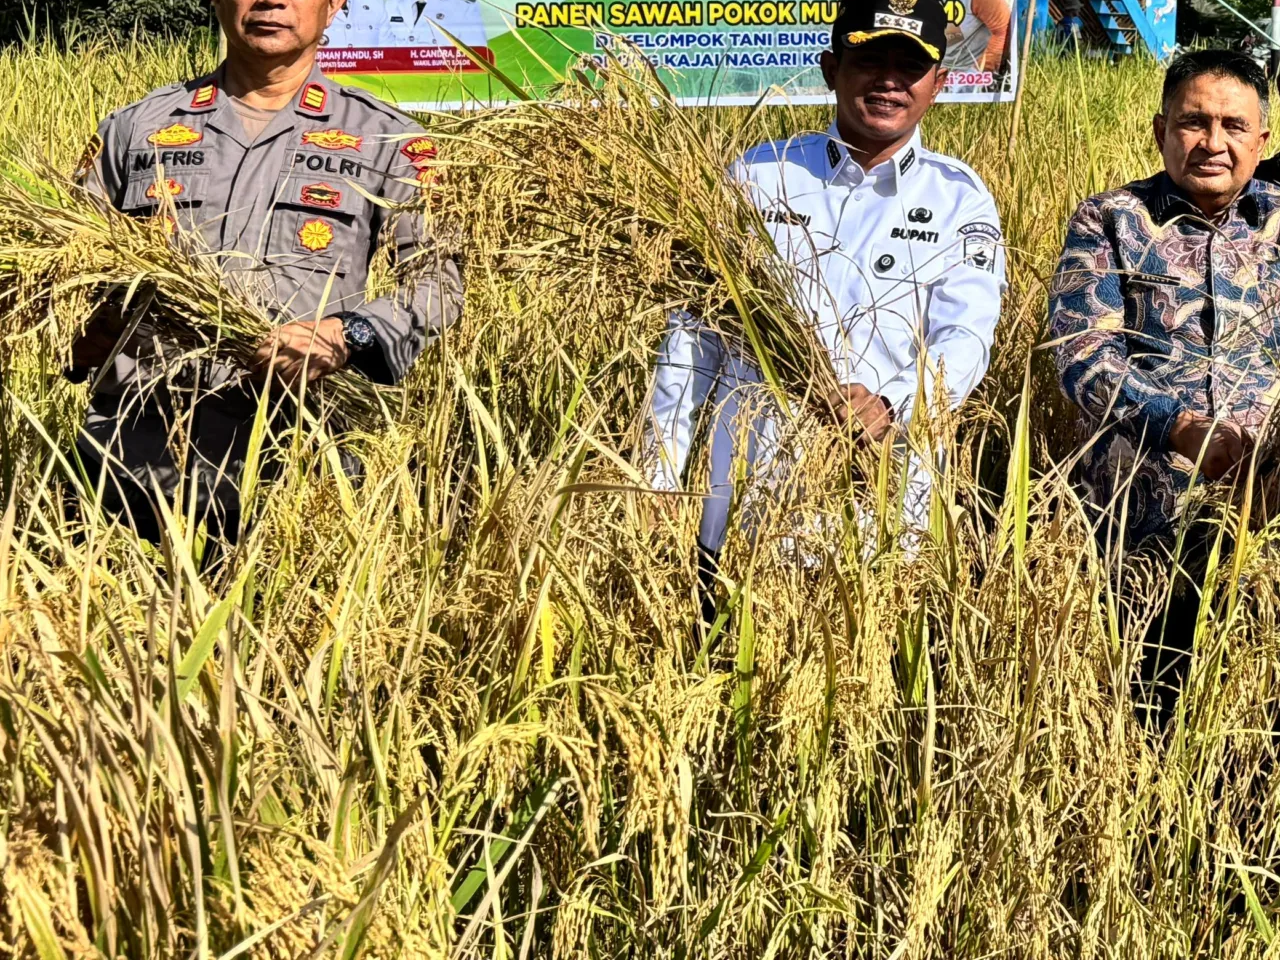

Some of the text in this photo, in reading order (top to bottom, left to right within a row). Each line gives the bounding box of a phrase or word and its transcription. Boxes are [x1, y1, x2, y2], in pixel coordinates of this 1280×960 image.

[609, 1, 701, 26] SAWAH
[709, 0, 795, 25] POKOK
[801, 0, 842, 25] MU
[729, 33, 772, 47] TANI
[778, 33, 829, 46] BUNG
[315, 50, 384, 61] RMAN PANDU, SH
[411, 49, 418, 58] H.
[665, 53, 721, 67] KAJAI
[727, 53, 797, 66] NAGARI
[957, 73, 992, 85] 2025
[133, 150, 205, 172] NAFRIS
[294, 153, 363, 178] POLRI
[890, 226, 939, 243] BUPATI
